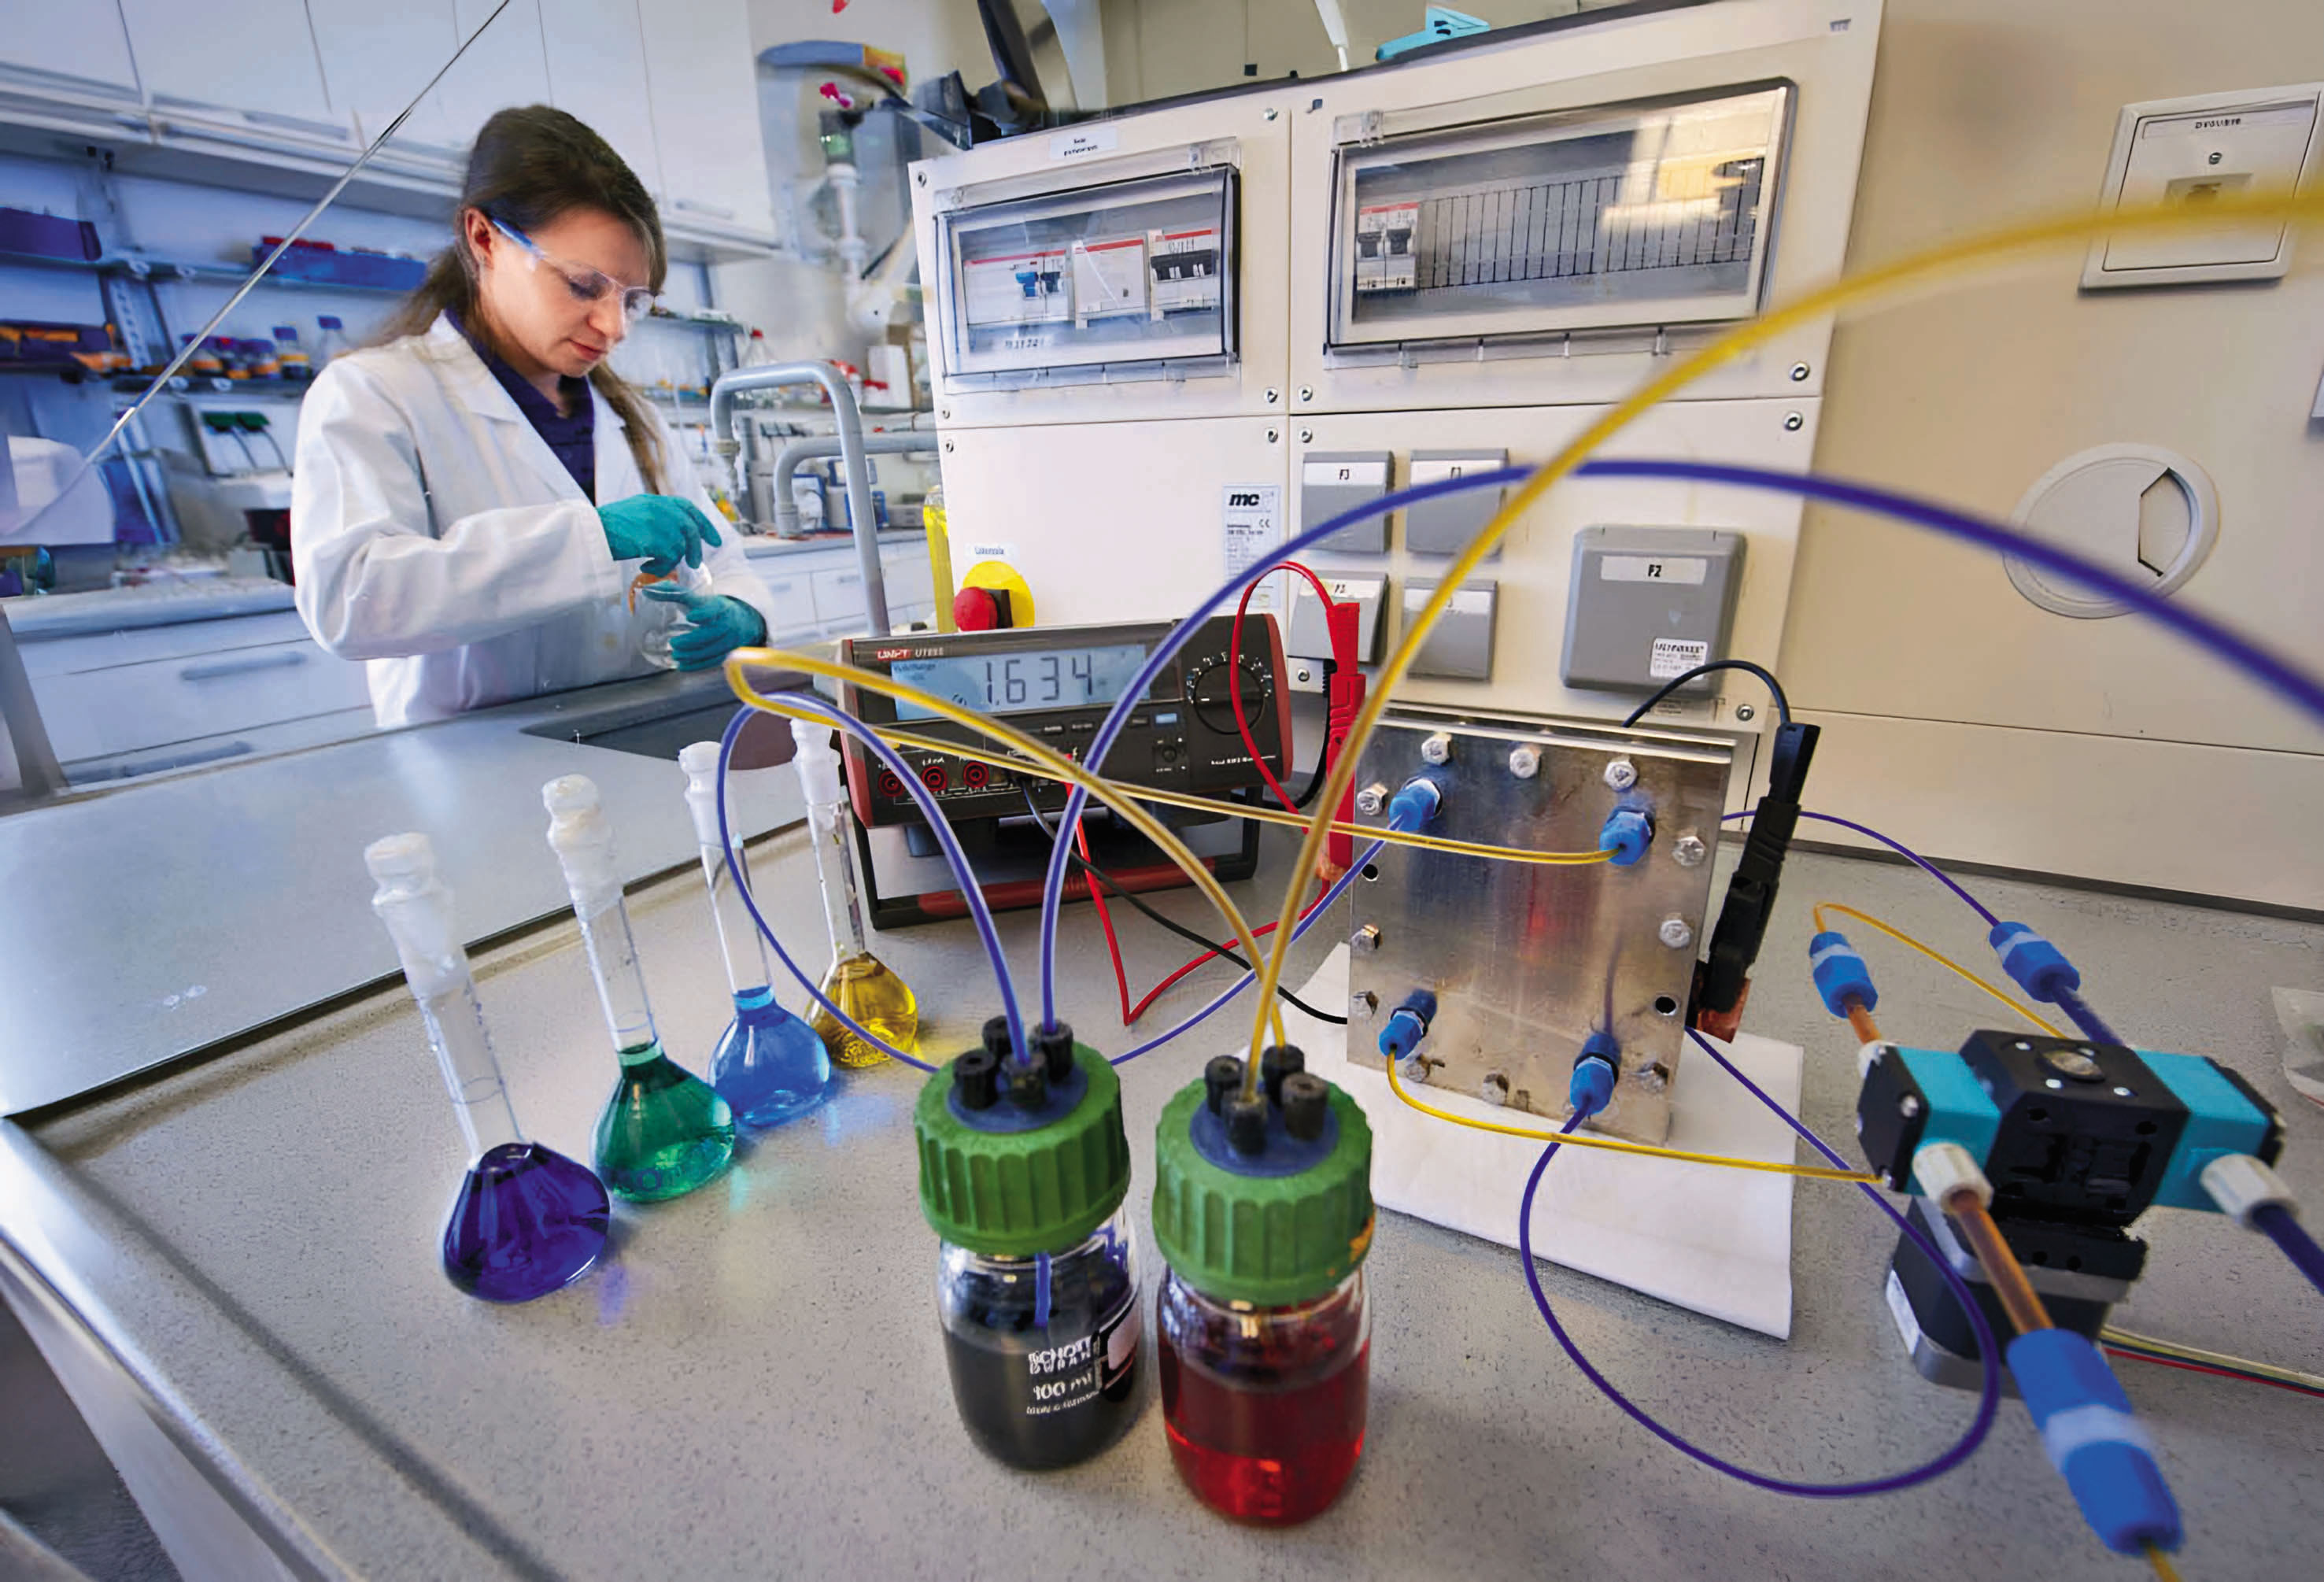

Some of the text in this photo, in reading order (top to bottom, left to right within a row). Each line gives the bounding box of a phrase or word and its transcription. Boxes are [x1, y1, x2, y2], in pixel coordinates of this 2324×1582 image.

[1229, 493, 1259, 506] mc
[1648, 564, 1662, 578] F2
[986, 654, 1093, 706] 1.634
[1033, 1381, 1066, 1400] 100
